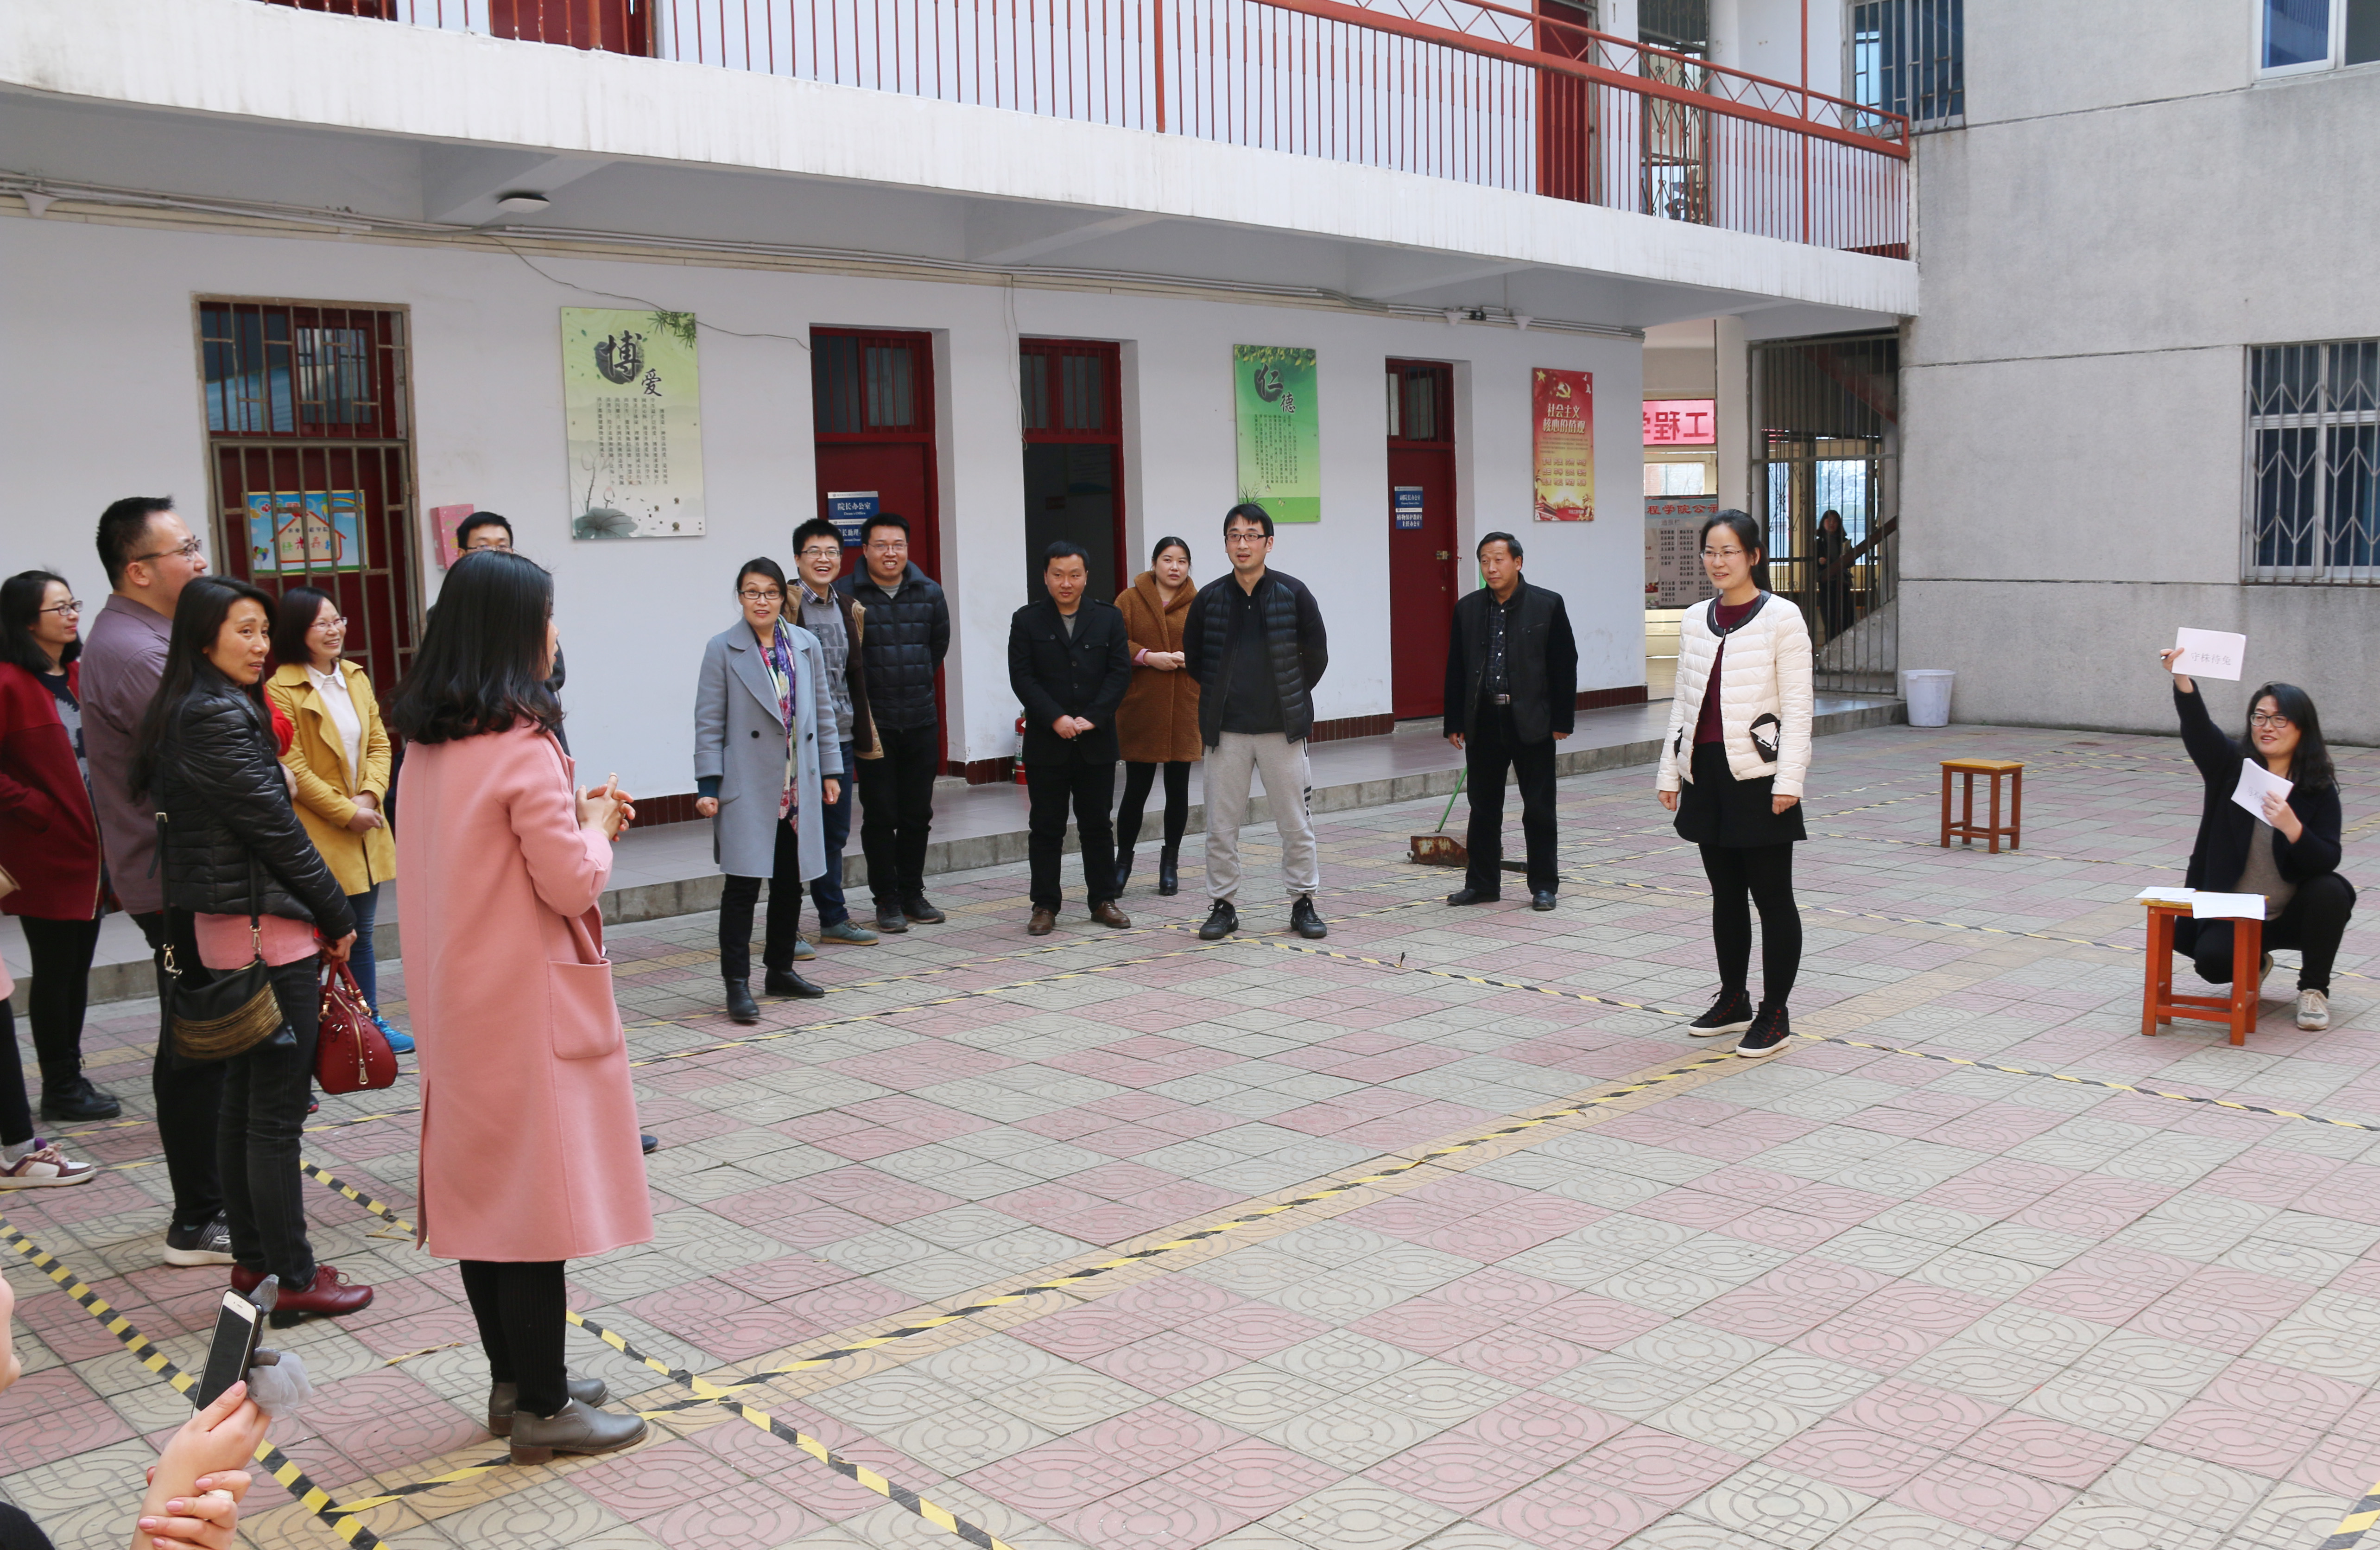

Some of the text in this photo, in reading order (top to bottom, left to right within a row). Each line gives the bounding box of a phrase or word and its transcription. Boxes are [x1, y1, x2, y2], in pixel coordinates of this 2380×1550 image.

[1547, 403, 1580, 418] 社会主义
[1542, 418, 1585, 434] 核心价值观
[837, 502, 871, 510] 院长办公室
[1645, 504, 1718, 515] 程学院公示
[2190, 652, 2231, 665] 守株待兔
